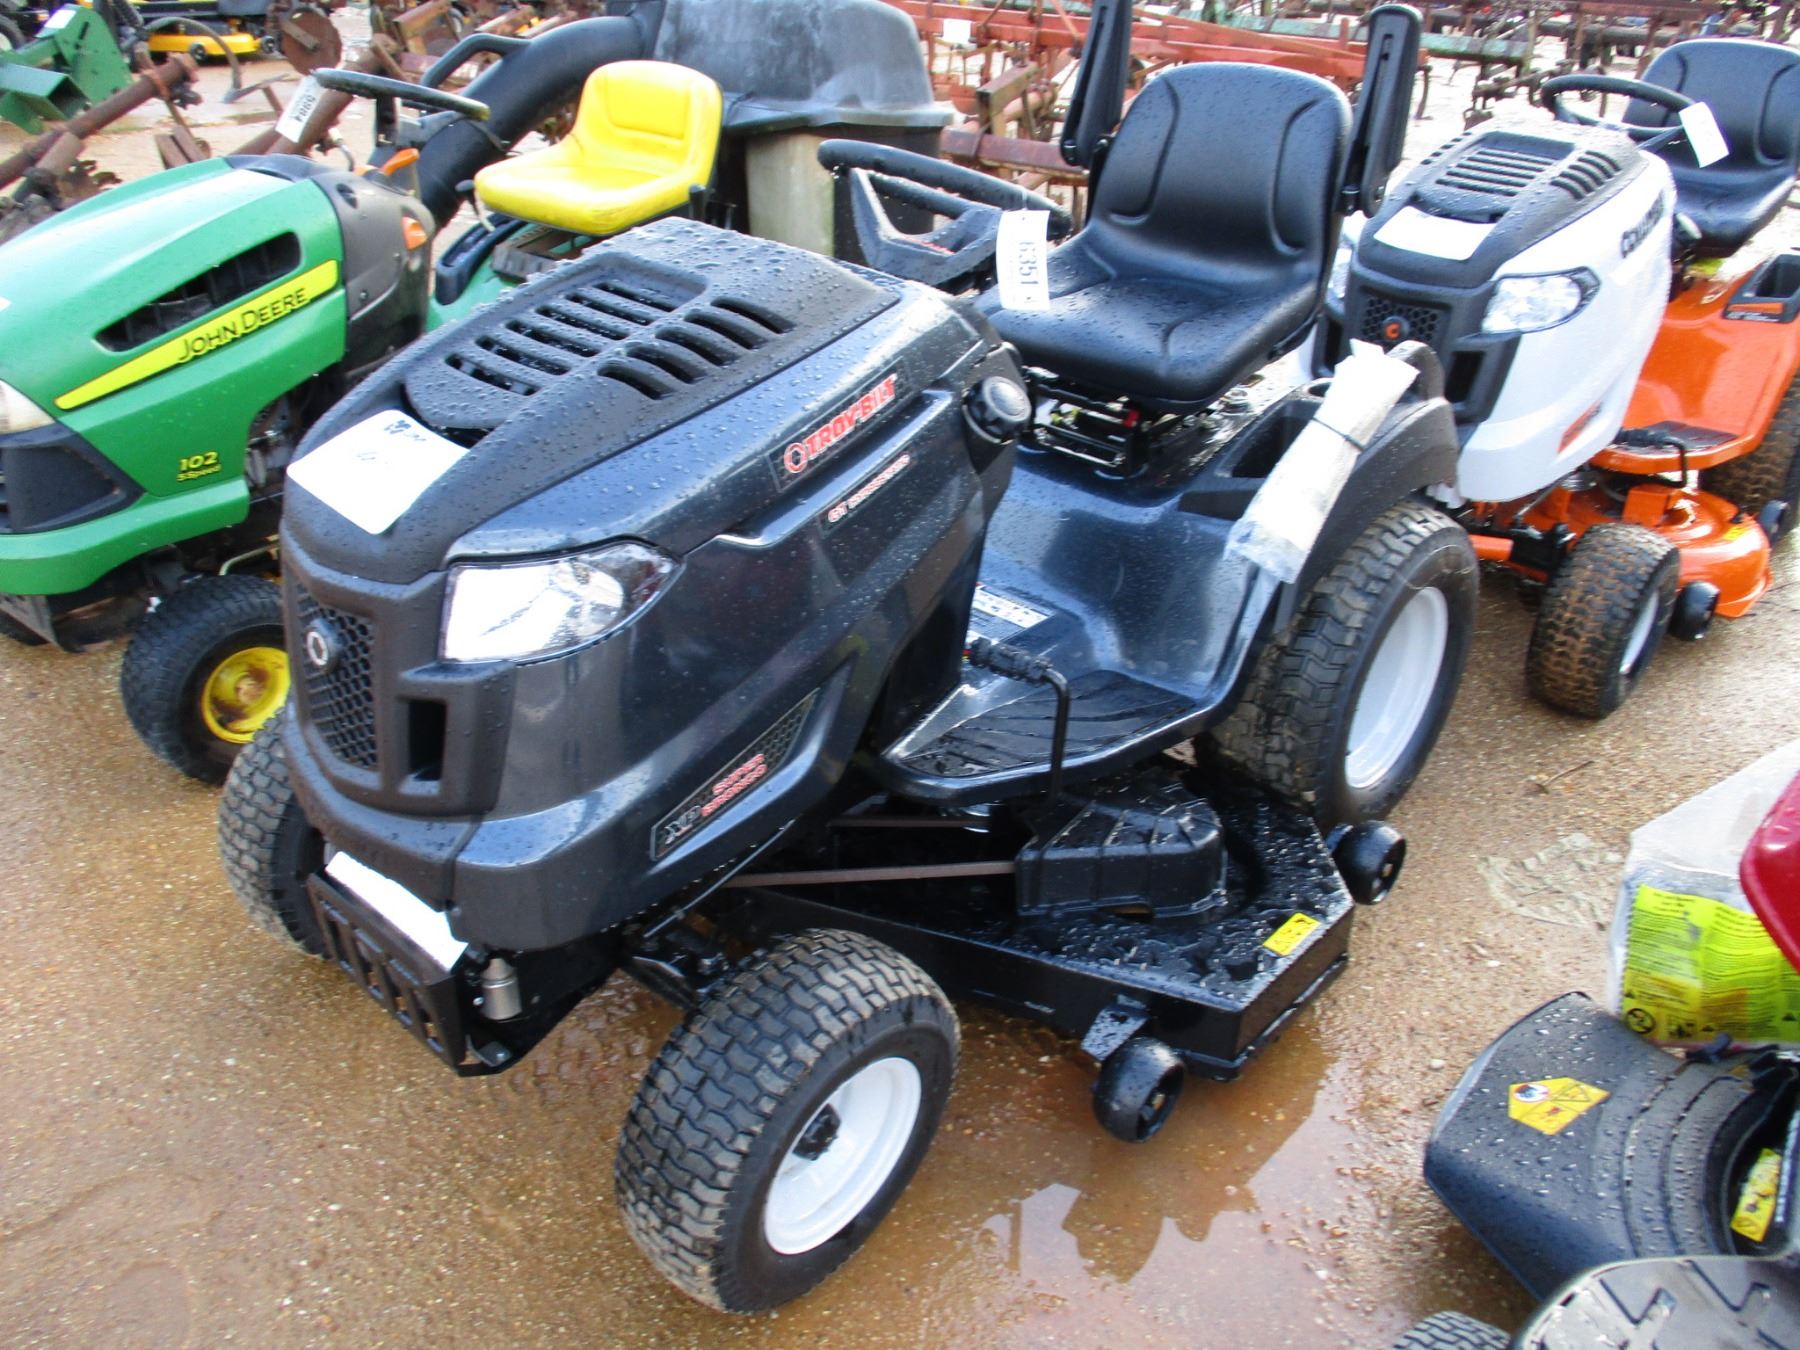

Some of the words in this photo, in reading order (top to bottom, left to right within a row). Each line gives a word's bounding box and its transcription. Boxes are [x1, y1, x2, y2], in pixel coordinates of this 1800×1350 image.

[1019, 241, 1039, 285] 6351
[178, 319, 238, 361] JOHN
[241, 287, 308, 331] DEERE
[180, 451, 218, 471] 102
[701, 764, 768, 816] BRONCO
[712, 753, 765, 796] SUPER
